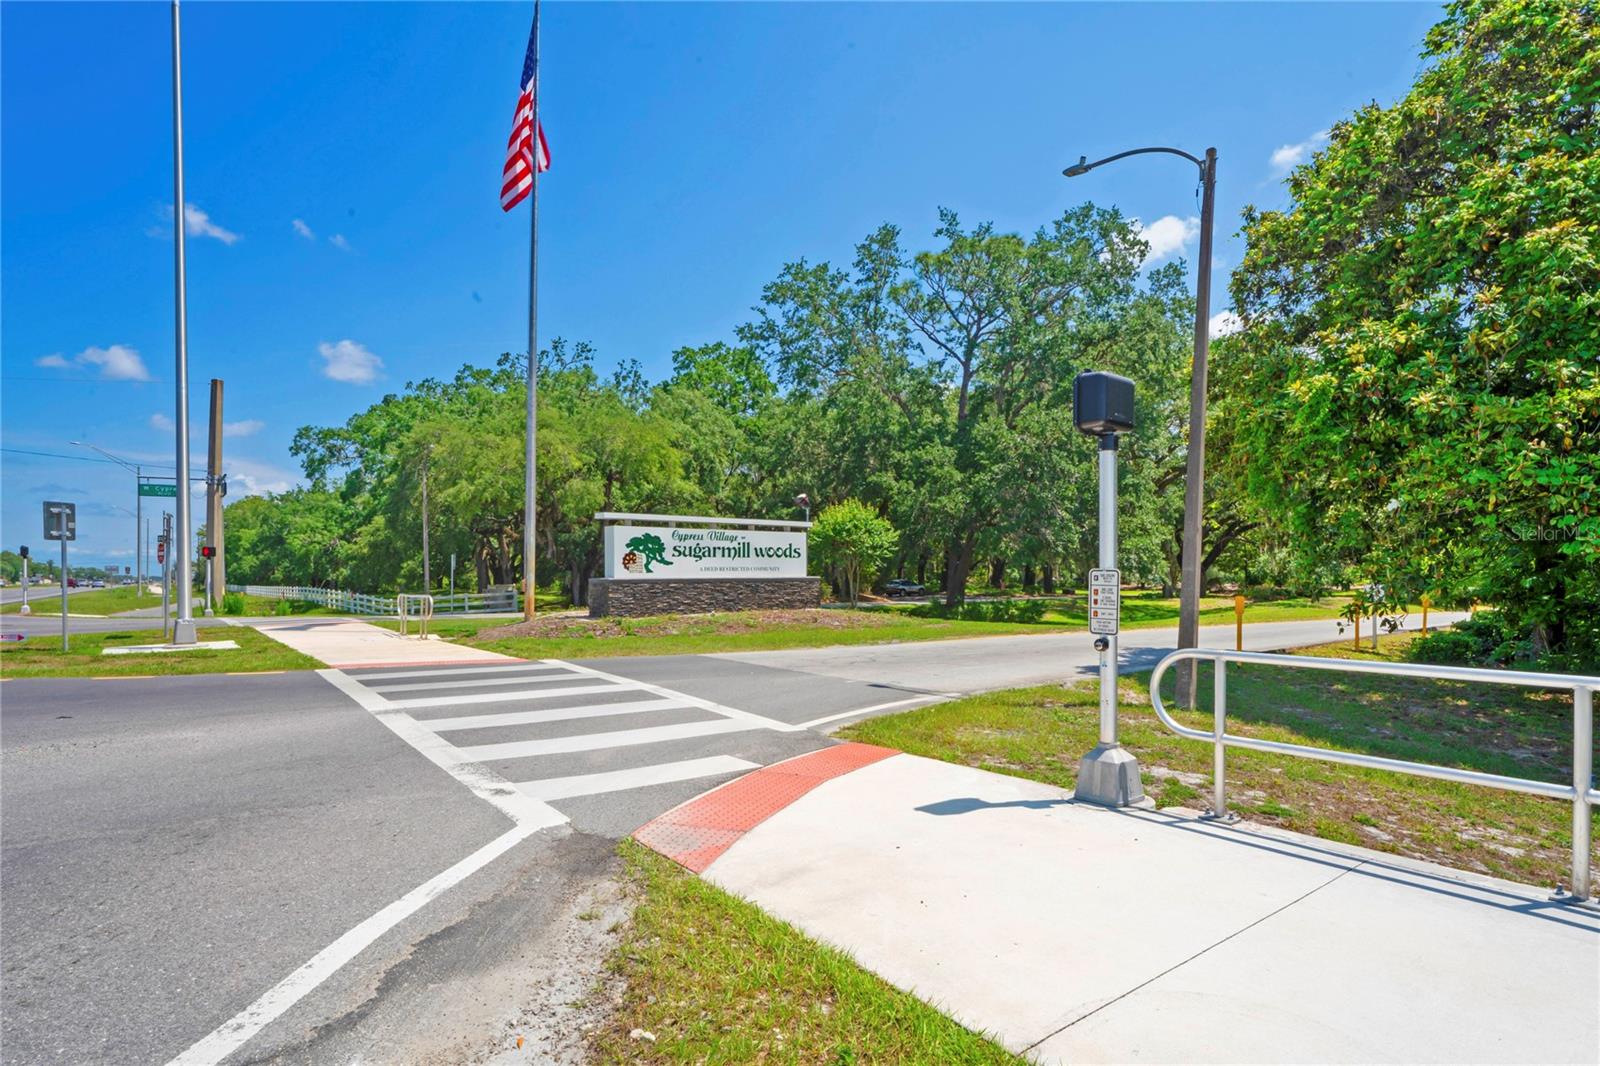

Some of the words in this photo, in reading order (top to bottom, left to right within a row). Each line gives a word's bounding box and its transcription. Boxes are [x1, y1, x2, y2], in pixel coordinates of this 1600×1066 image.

[671, 529, 704, 543] Cypress
[707, 530, 738, 544] Village
[671, 542, 750, 562] sugarmill
[754, 543, 801, 559] woods
